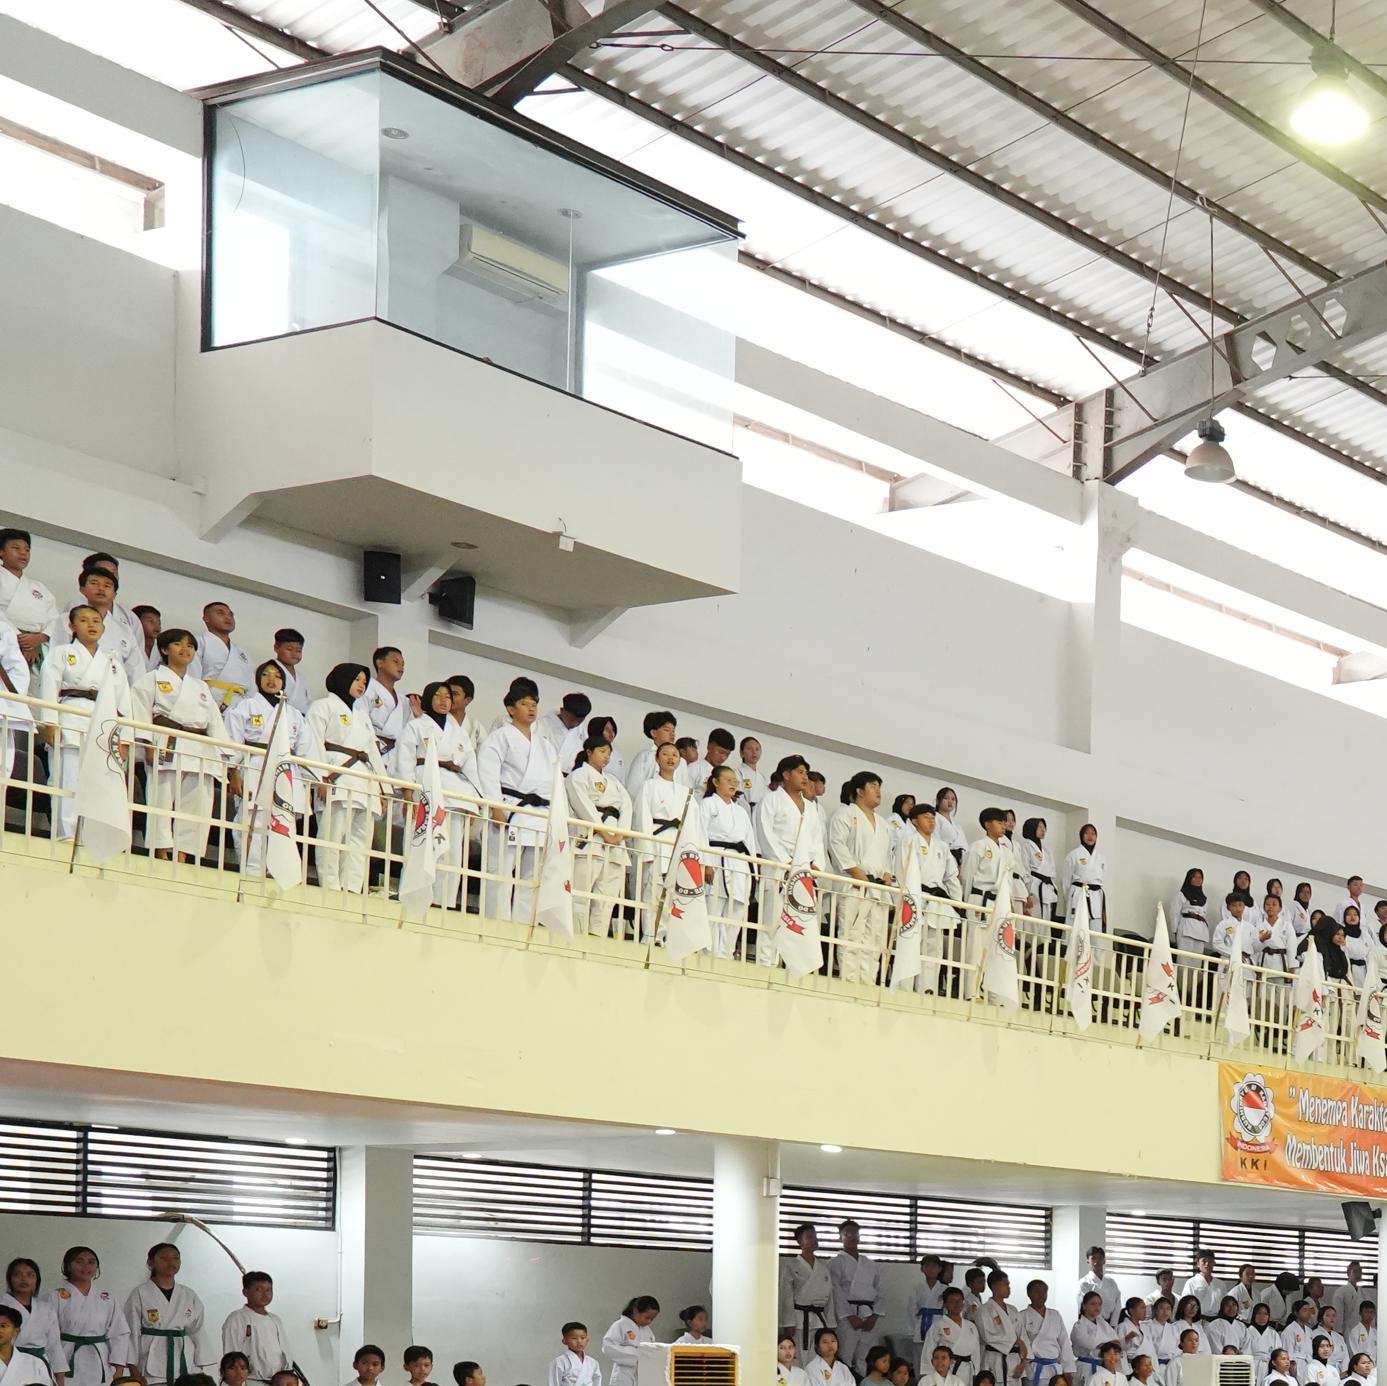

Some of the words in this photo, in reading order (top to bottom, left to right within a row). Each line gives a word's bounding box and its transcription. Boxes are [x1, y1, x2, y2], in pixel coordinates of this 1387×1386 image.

[1298, 1088, 1348, 1129] Menempa
[1285, 1134, 1347, 1173] Membentuk
[1349, 1141, 1370, 1175] Jiwa
